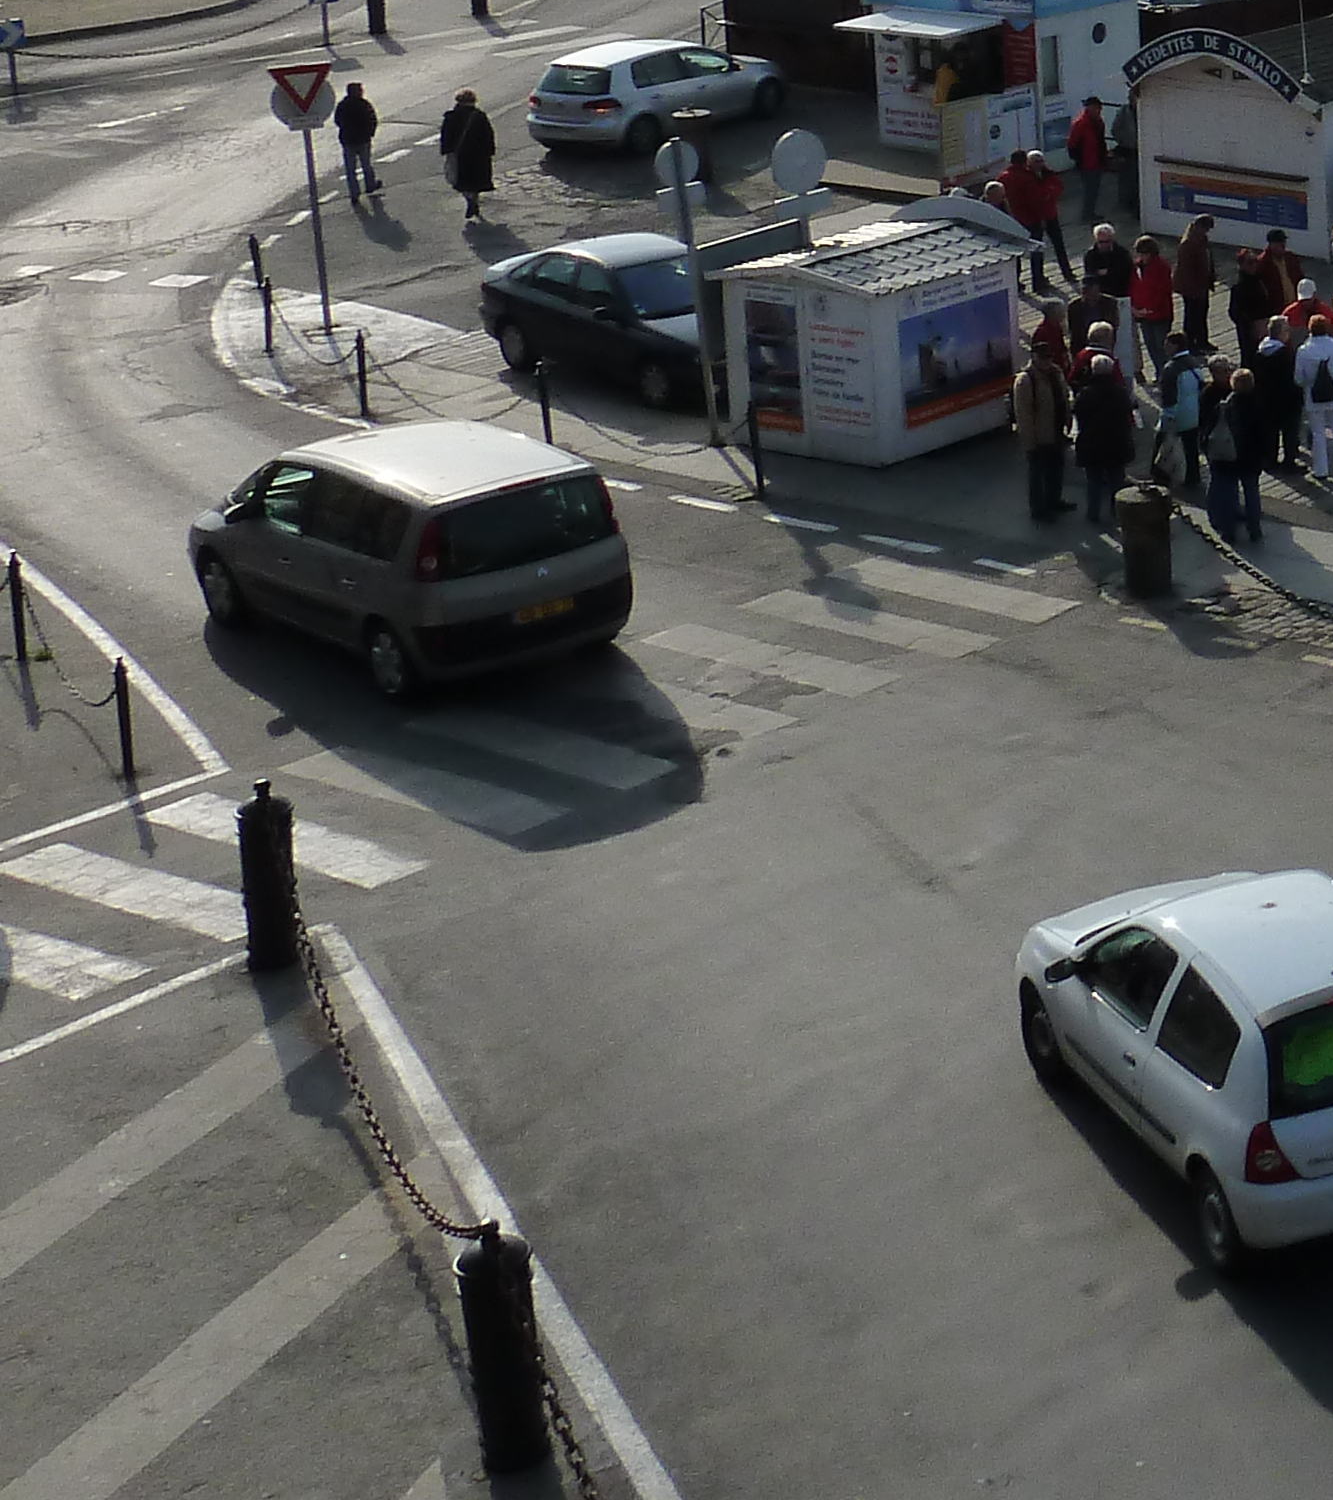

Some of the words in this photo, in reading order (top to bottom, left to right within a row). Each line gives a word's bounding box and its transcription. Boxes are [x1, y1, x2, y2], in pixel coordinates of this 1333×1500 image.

[1137, 35, 1195, 69] VEDETTES
[1203, 35, 1220, 51] DE
[1244, 51, 1282, 86] MALO
